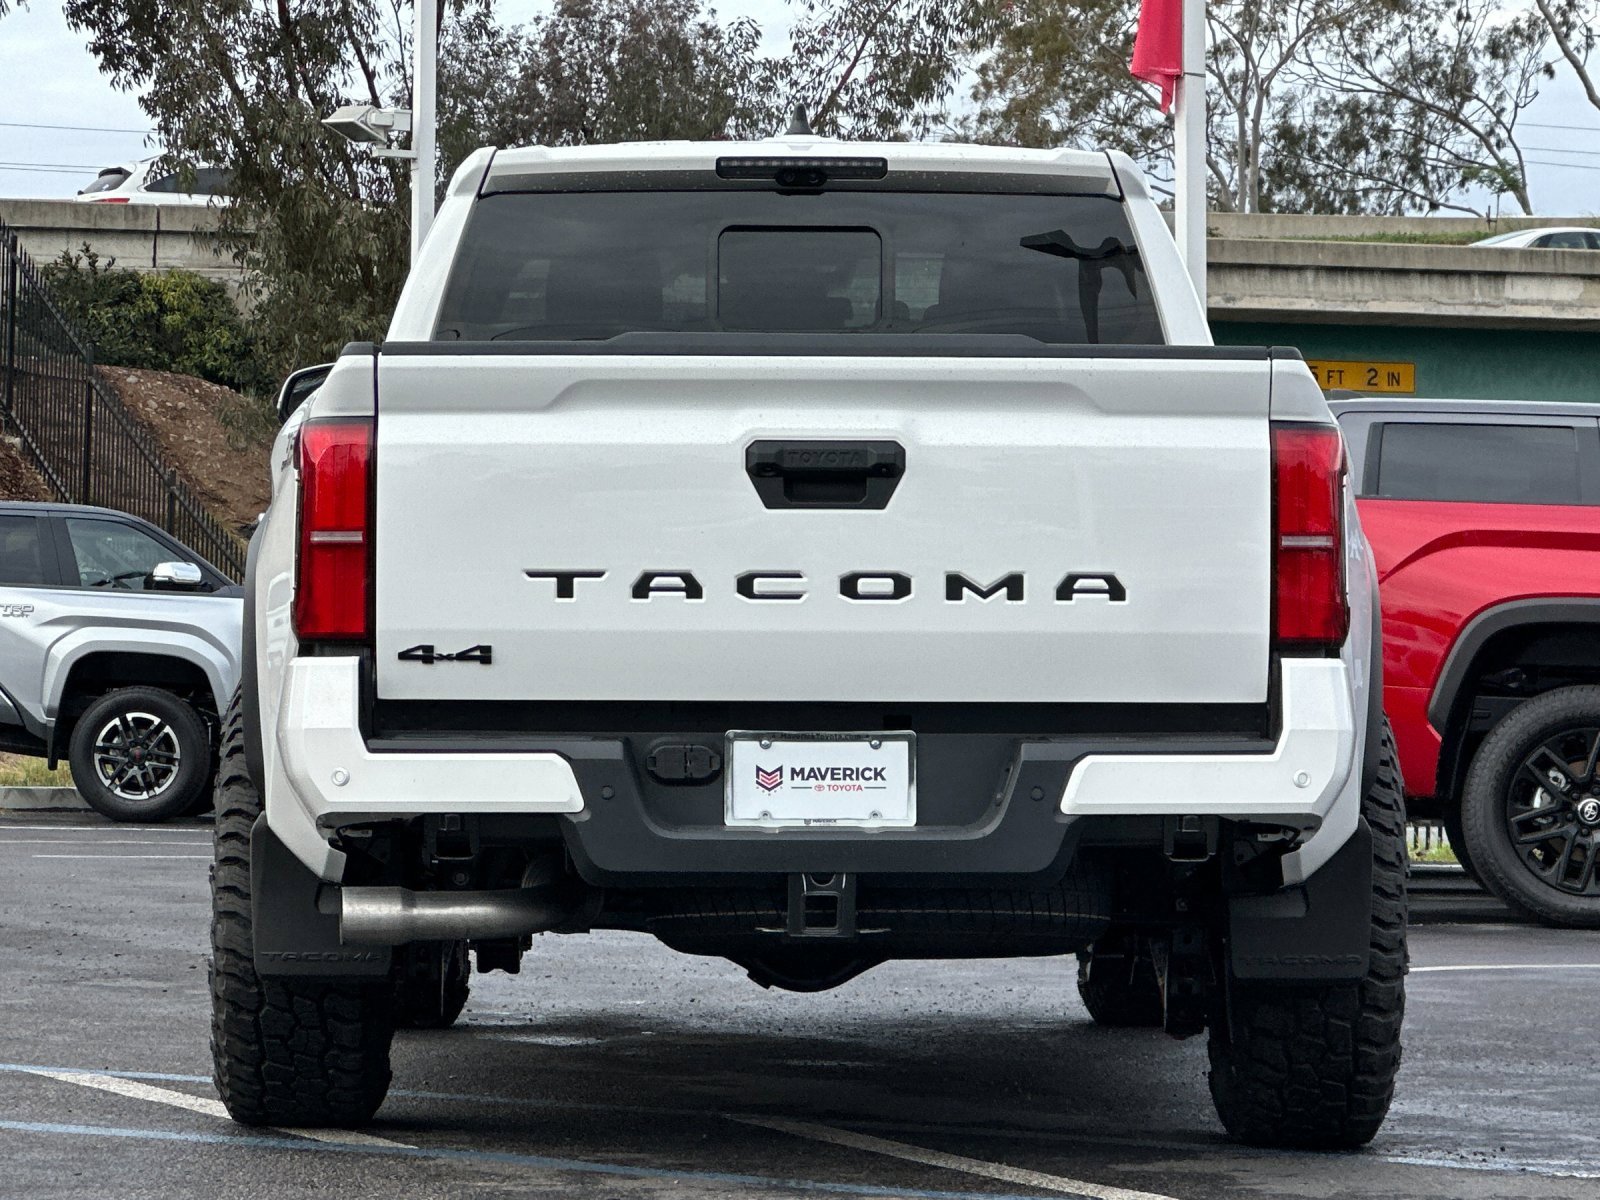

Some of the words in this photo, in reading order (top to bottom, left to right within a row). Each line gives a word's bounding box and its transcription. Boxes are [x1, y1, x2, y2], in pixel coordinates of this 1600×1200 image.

[1327, 370, 1344, 385] FT
[1367, 368, 1378, 386] 2
[1388, 372, 1400, 386] IN
[788, 451, 861, 464] TOYOTA
[522, 569, 1129, 603] TACOMA
[790, 767, 887, 781] MAVERICK
[827, 784, 864, 792] TOYOTA
